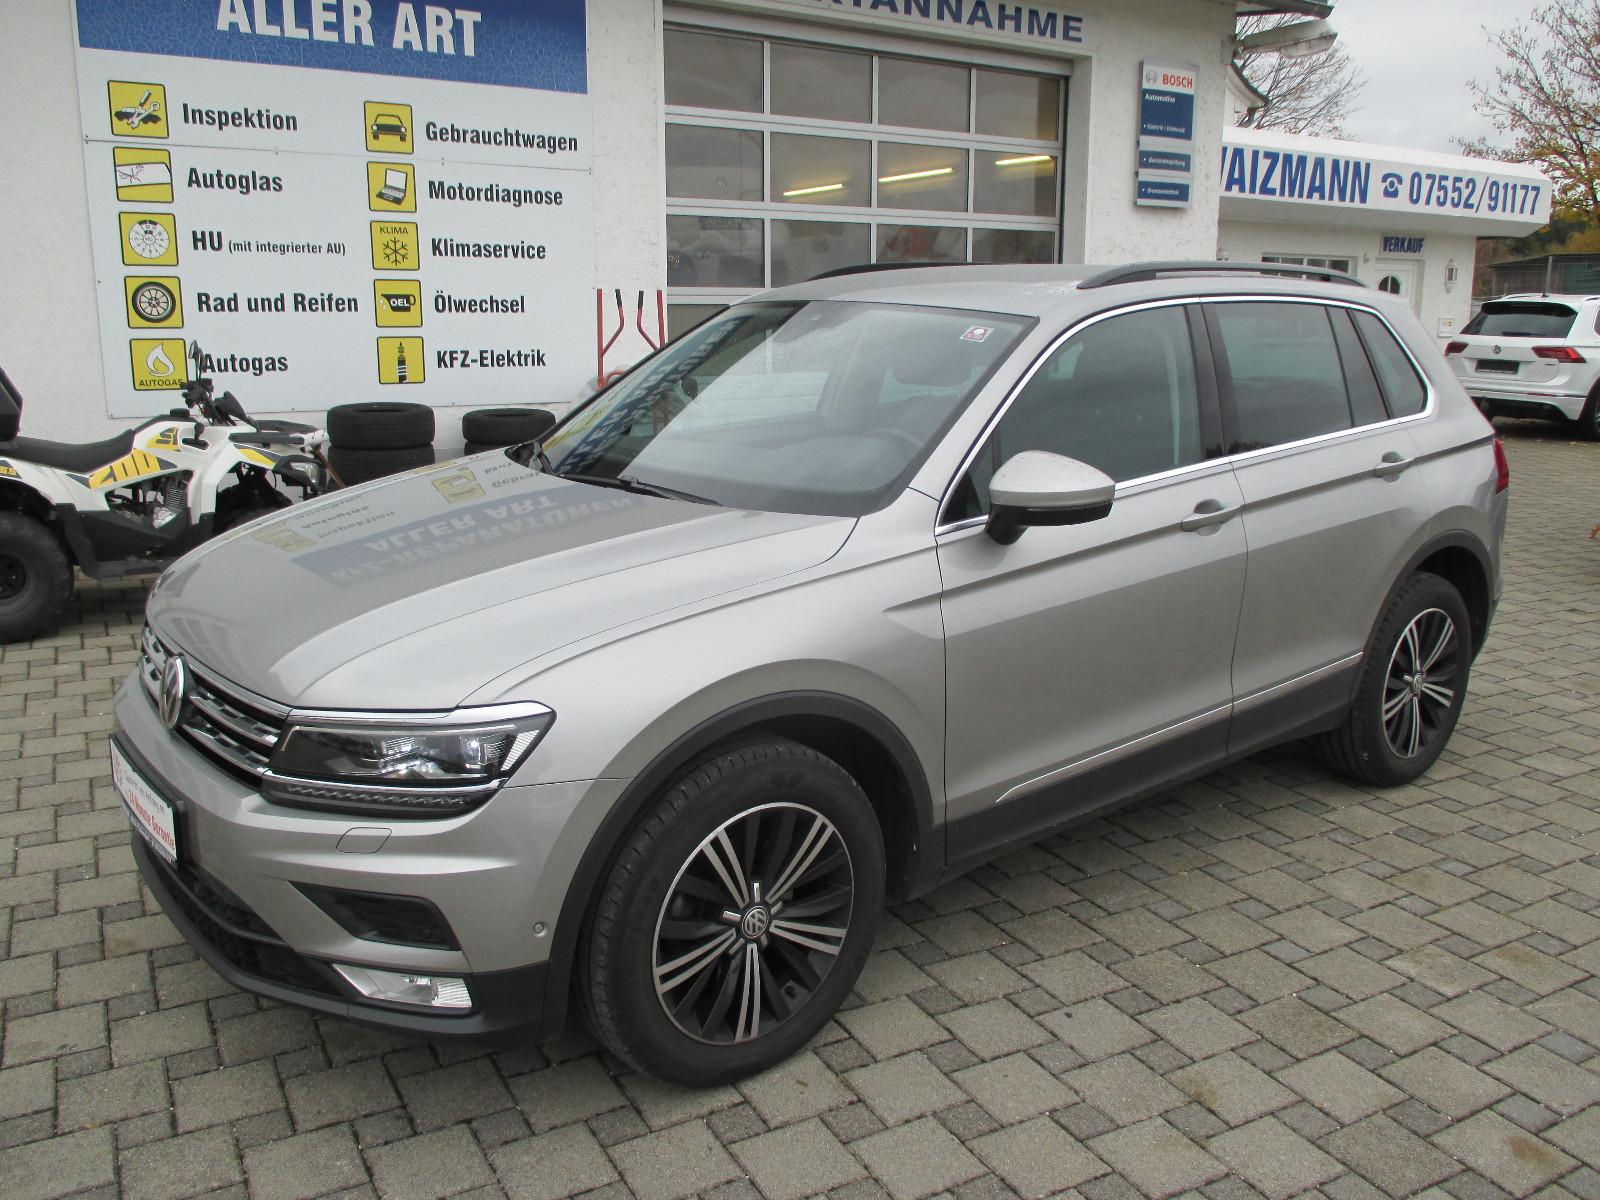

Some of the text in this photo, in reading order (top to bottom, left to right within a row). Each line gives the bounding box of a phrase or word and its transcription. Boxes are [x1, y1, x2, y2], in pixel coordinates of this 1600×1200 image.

[216, 0, 482, 57] ALLER ART
[1162, 74, 1193, 89] BOSCH
[182, 103, 298, 131] Inspektion
[425, 121, 578, 154] Gebrauchtwagen
[187, 167, 283, 195] Autoglas
[428, 180, 563, 208] Motordiagnose
[1408, 171, 1541, 216] 07552/91177
[379, 226, 409, 235] KLIMA
[192, 230, 346, 256] HU (mit integrierter AU)
[431, 238, 546, 259] Klimaservice
[1383, 235, 1425, 254] VERKAUF
[196, 292, 359, 313] Rad und Reifen
[390, 298, 410, 308] OEL
[434, 290, 526, 313] Ölwechsel
[201, 353, 289, 376] Autogas
[437, 349, 546, 368] KFZ-Elektrik
[139, 378, 184, 388] AUTOGAS
